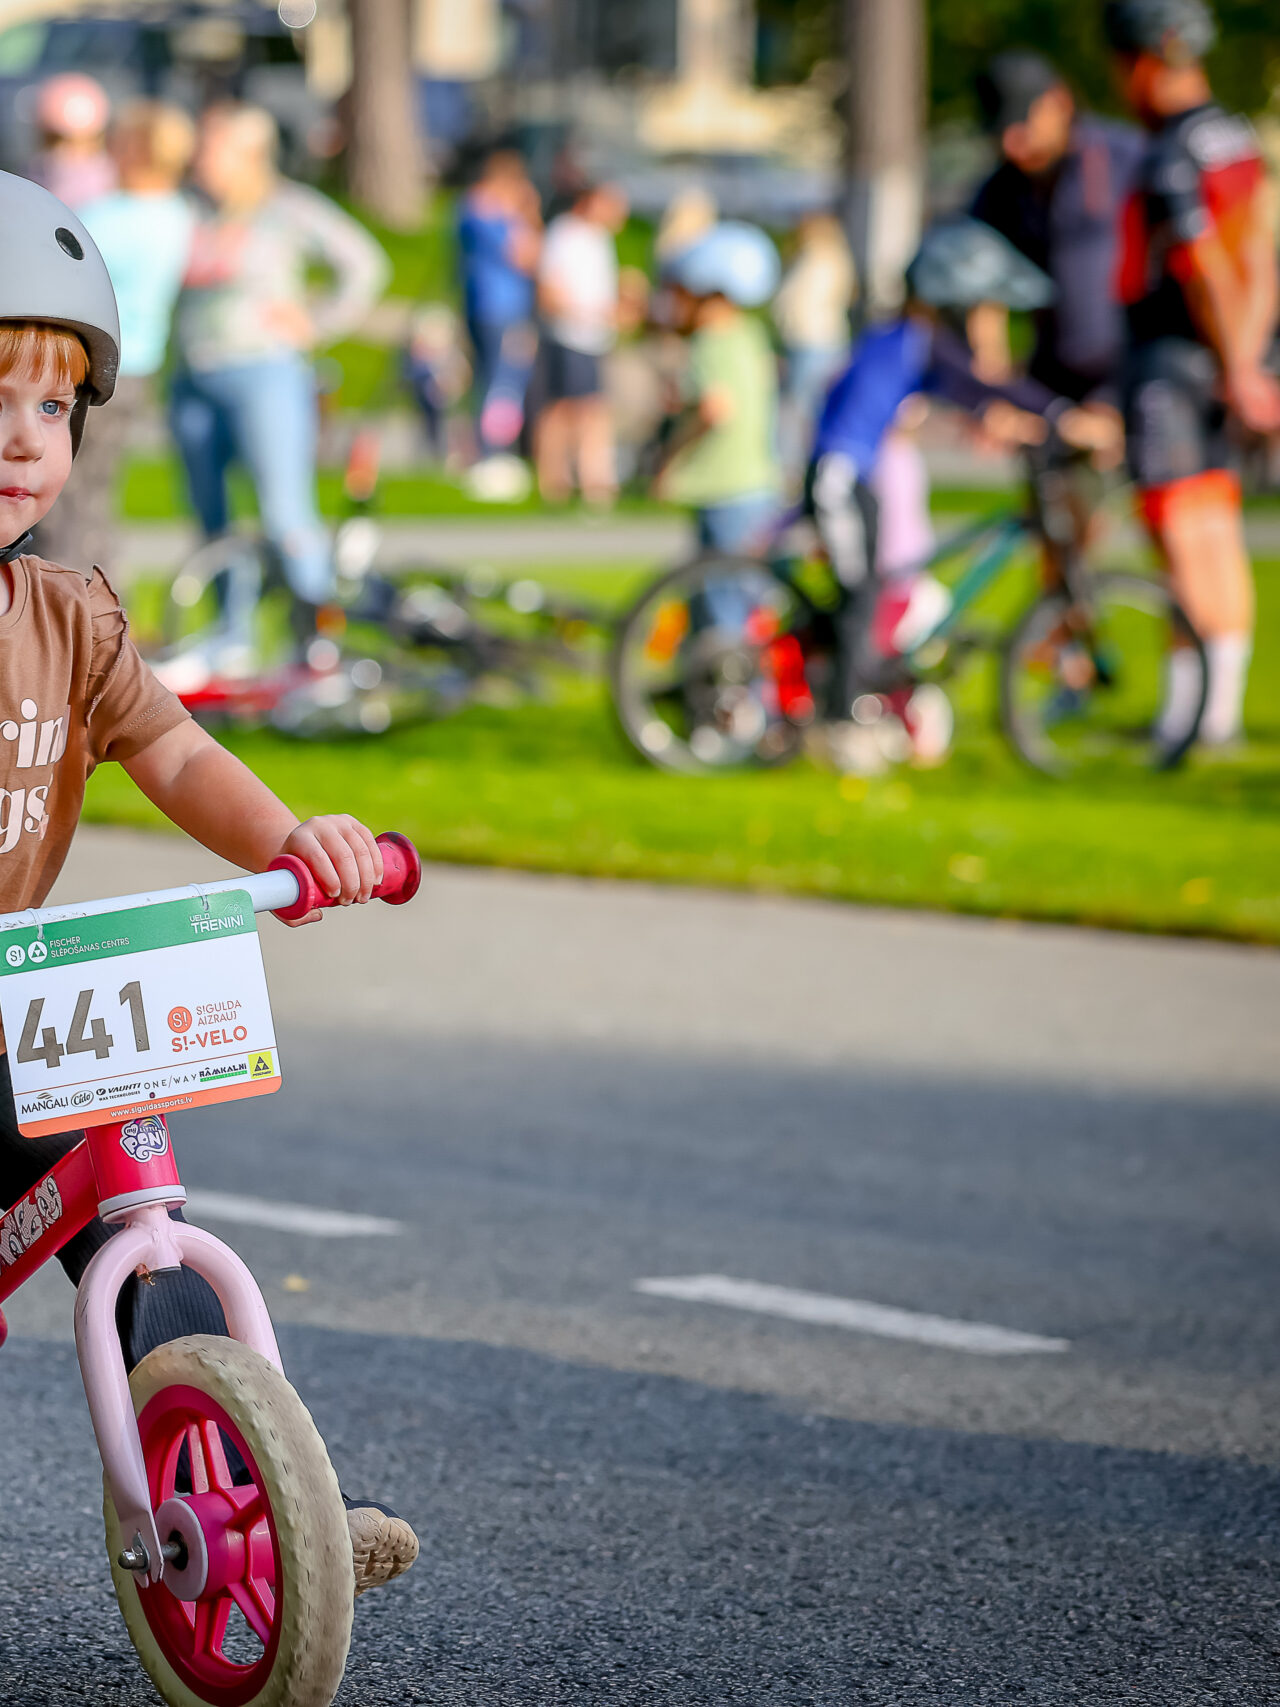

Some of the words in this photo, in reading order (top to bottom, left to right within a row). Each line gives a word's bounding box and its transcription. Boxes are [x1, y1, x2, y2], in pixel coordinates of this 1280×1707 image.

[189, 912, 210, 922] VELO
[190, 914, 244, 934] TRENIŅI
[49, 936, 81, 948] FISCHER
[101, 937, 130, 949] CENTRS
[17, 980, 150, 1069] 441
[197, 1011, 237, 1026] AIZRAUJ
[171, 1025, 248, 1053] S!-VELO
[108, 1082, 141, 1094] VAUHTI
[21, 1096, 69, 1115] MANGAĻI
[73, 1093, 92, 1106] Cido
[122, 1129, 167, 1160] PONY
